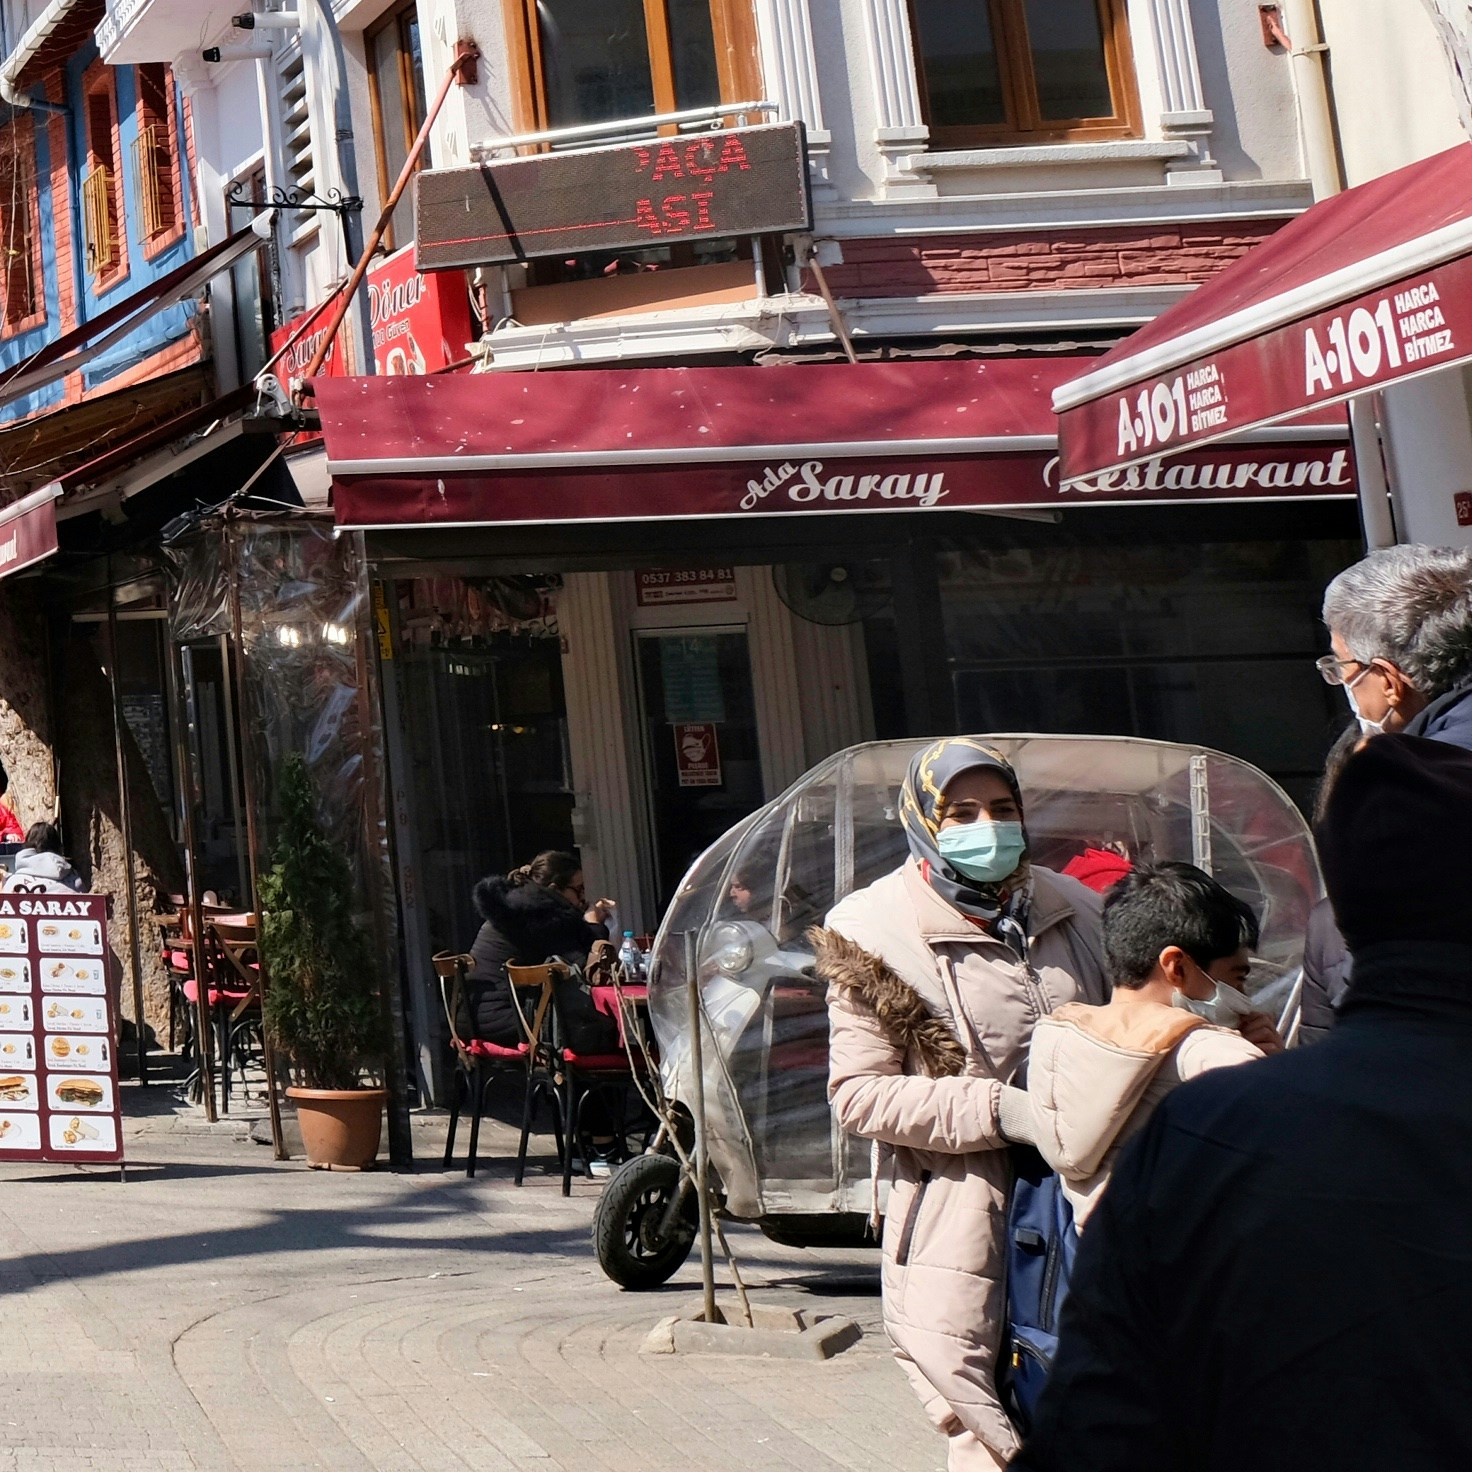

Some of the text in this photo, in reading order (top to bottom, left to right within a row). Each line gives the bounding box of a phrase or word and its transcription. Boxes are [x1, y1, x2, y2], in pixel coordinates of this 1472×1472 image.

[368, 274, 426, 330] Döner
[1395, 281, 1440, 315] HARCA
[1399, 305, 1445, 338] HARCA
[1404, 328, 1455, 364] BİTMEZ
[1187, 364, 1220, 392] HARCA
[1189, 388, 1222, 412] HARCA
[1191, 405, 1228, 433] BİTMEZ
[739, 459, 799, 511] Ada
[788, 461, 950, 507] Saray
[642, 568, 733, 584] 0537 383 84 81
[19, 900, 92, 916] SARAY
